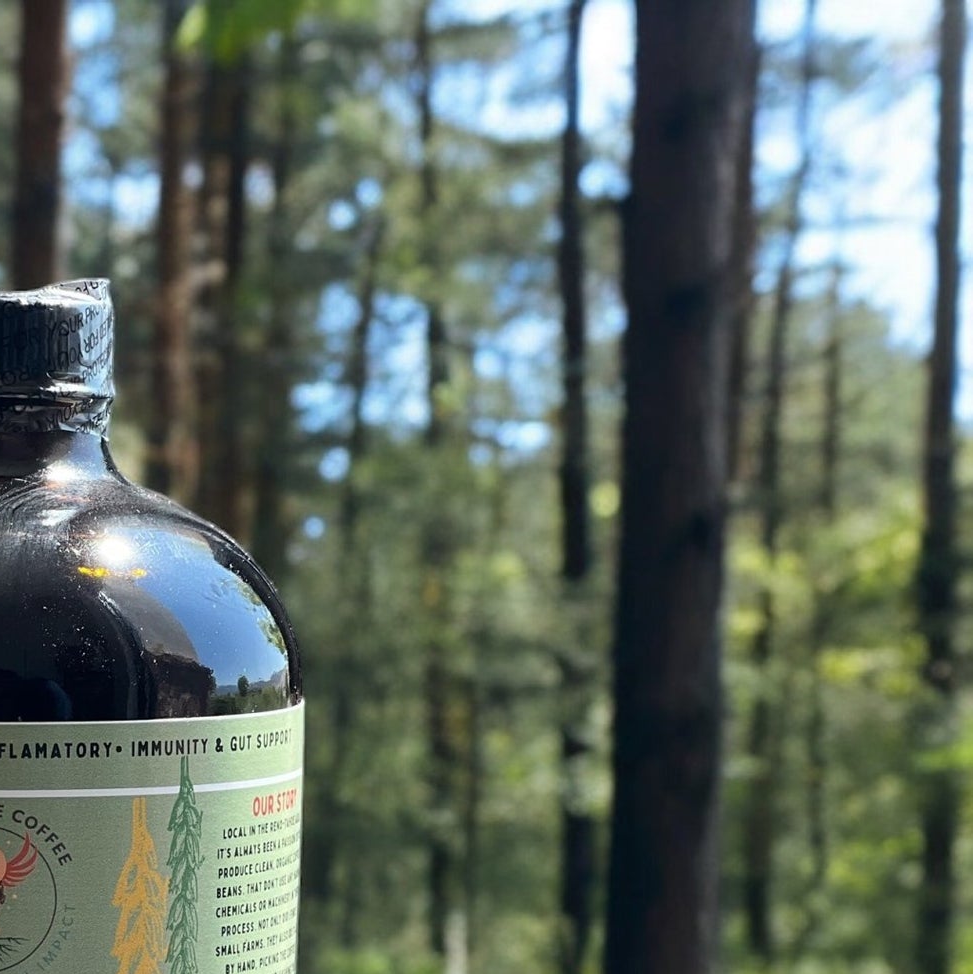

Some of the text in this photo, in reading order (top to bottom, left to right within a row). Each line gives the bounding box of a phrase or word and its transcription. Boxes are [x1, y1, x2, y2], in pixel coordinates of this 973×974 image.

[131, 738, 209, 758] IMMUNITY
[215, 737, 224, 753] &
[230, 734, 252, 752] GUT
[256, 728, 292, 749] SUPPORT
[253, 795, 274, 817] OUR
[11, 809, 73, 866] COFFEE
[223, 822, 269, 839] LOCAL IN THE
[217, 848, 231, 860] IT'S
[234, 843, 261, 858] ALWAYS
[263, 840, 277, 854] BEEN
[218, 863, 253, 879] PRODUCE
[247, 881, 262, 894] THAT
[215, 899, 267, 918] CHEMICALS OR
[258, 918, 269, 930] NOT
[35, 904, 76, 972] IMPACT
[215, 943, 240, 957] SMALL
[225, 963, 235, 974] BY
